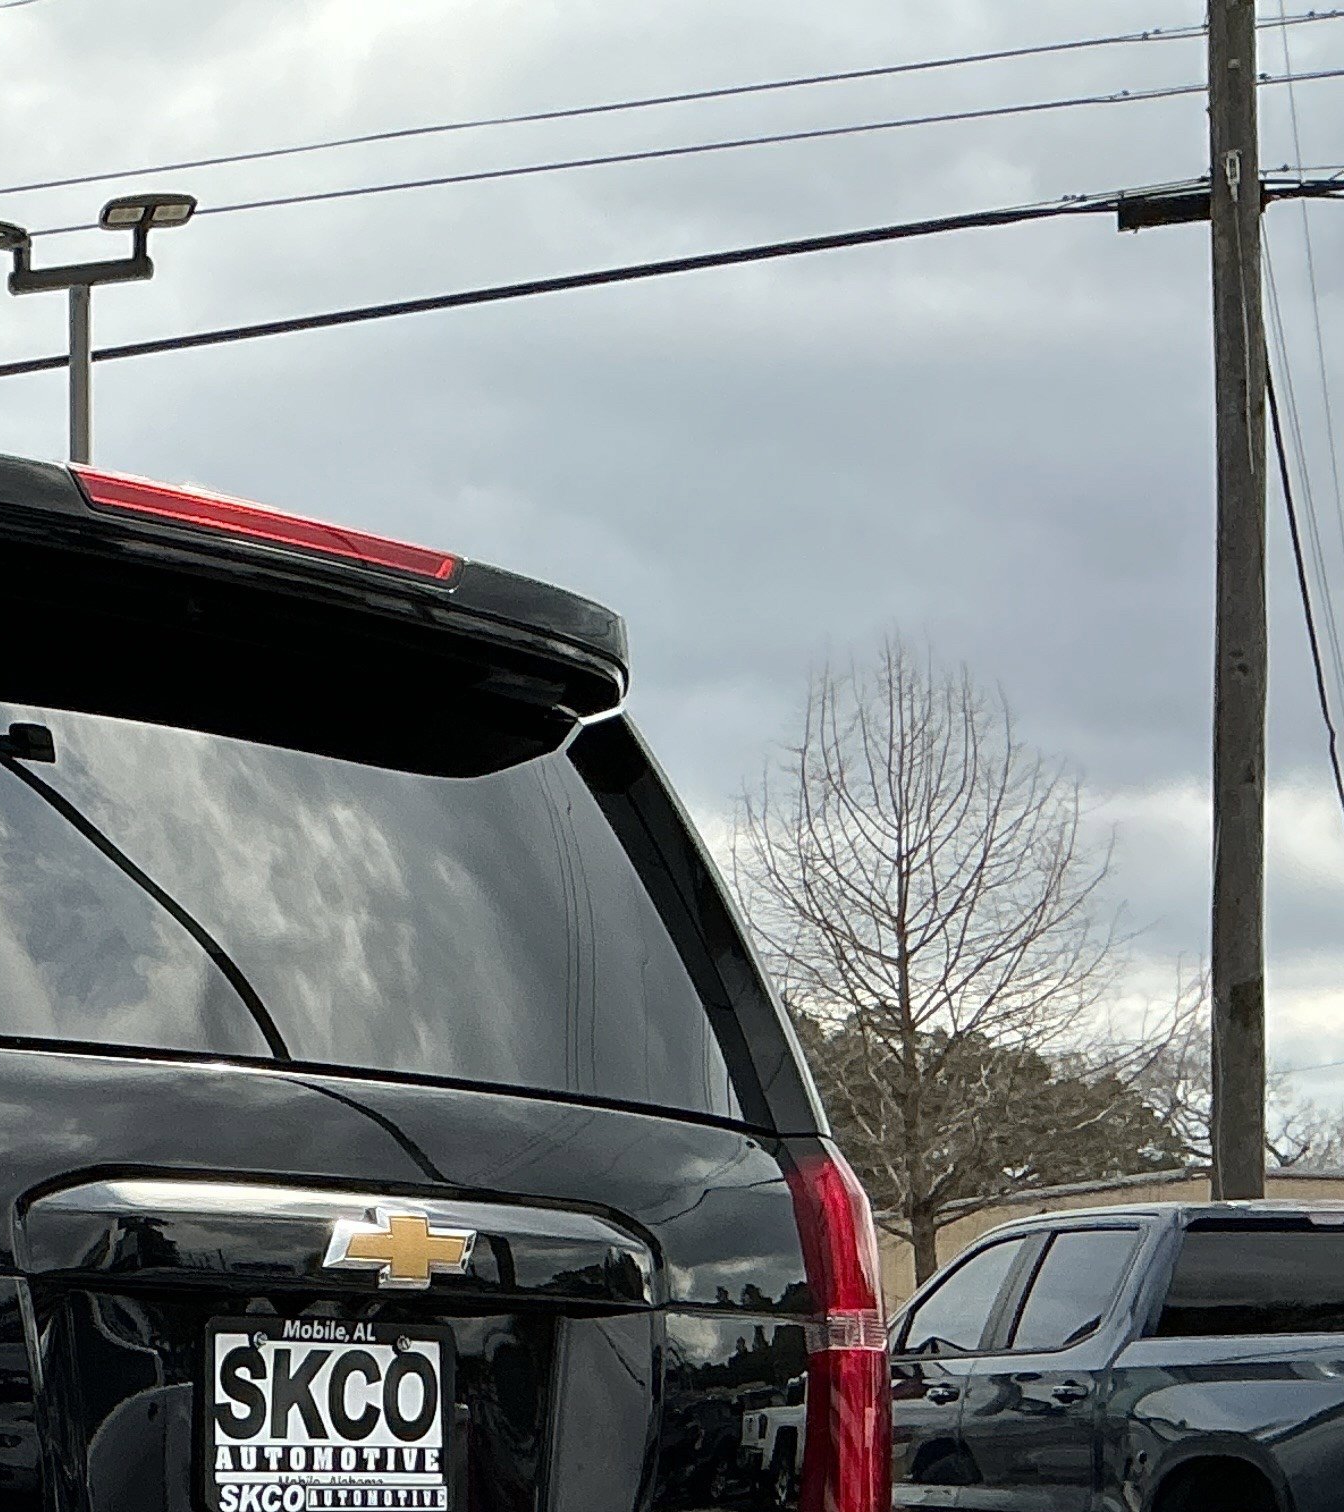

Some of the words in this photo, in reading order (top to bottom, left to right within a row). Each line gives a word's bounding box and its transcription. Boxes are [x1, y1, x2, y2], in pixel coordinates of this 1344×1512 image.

[282, 1319, 353, 1343] Mobile,
[354, 1320, 376, 1341] AL
[214, 1345, 439, 1442] SKCO
[215, 1447, 440, 1472] AUTOMOTIVE
[218, 1484, 306, 1512] SKCO
[309, 1488, 446, 1508] AUTOMOTIVE
